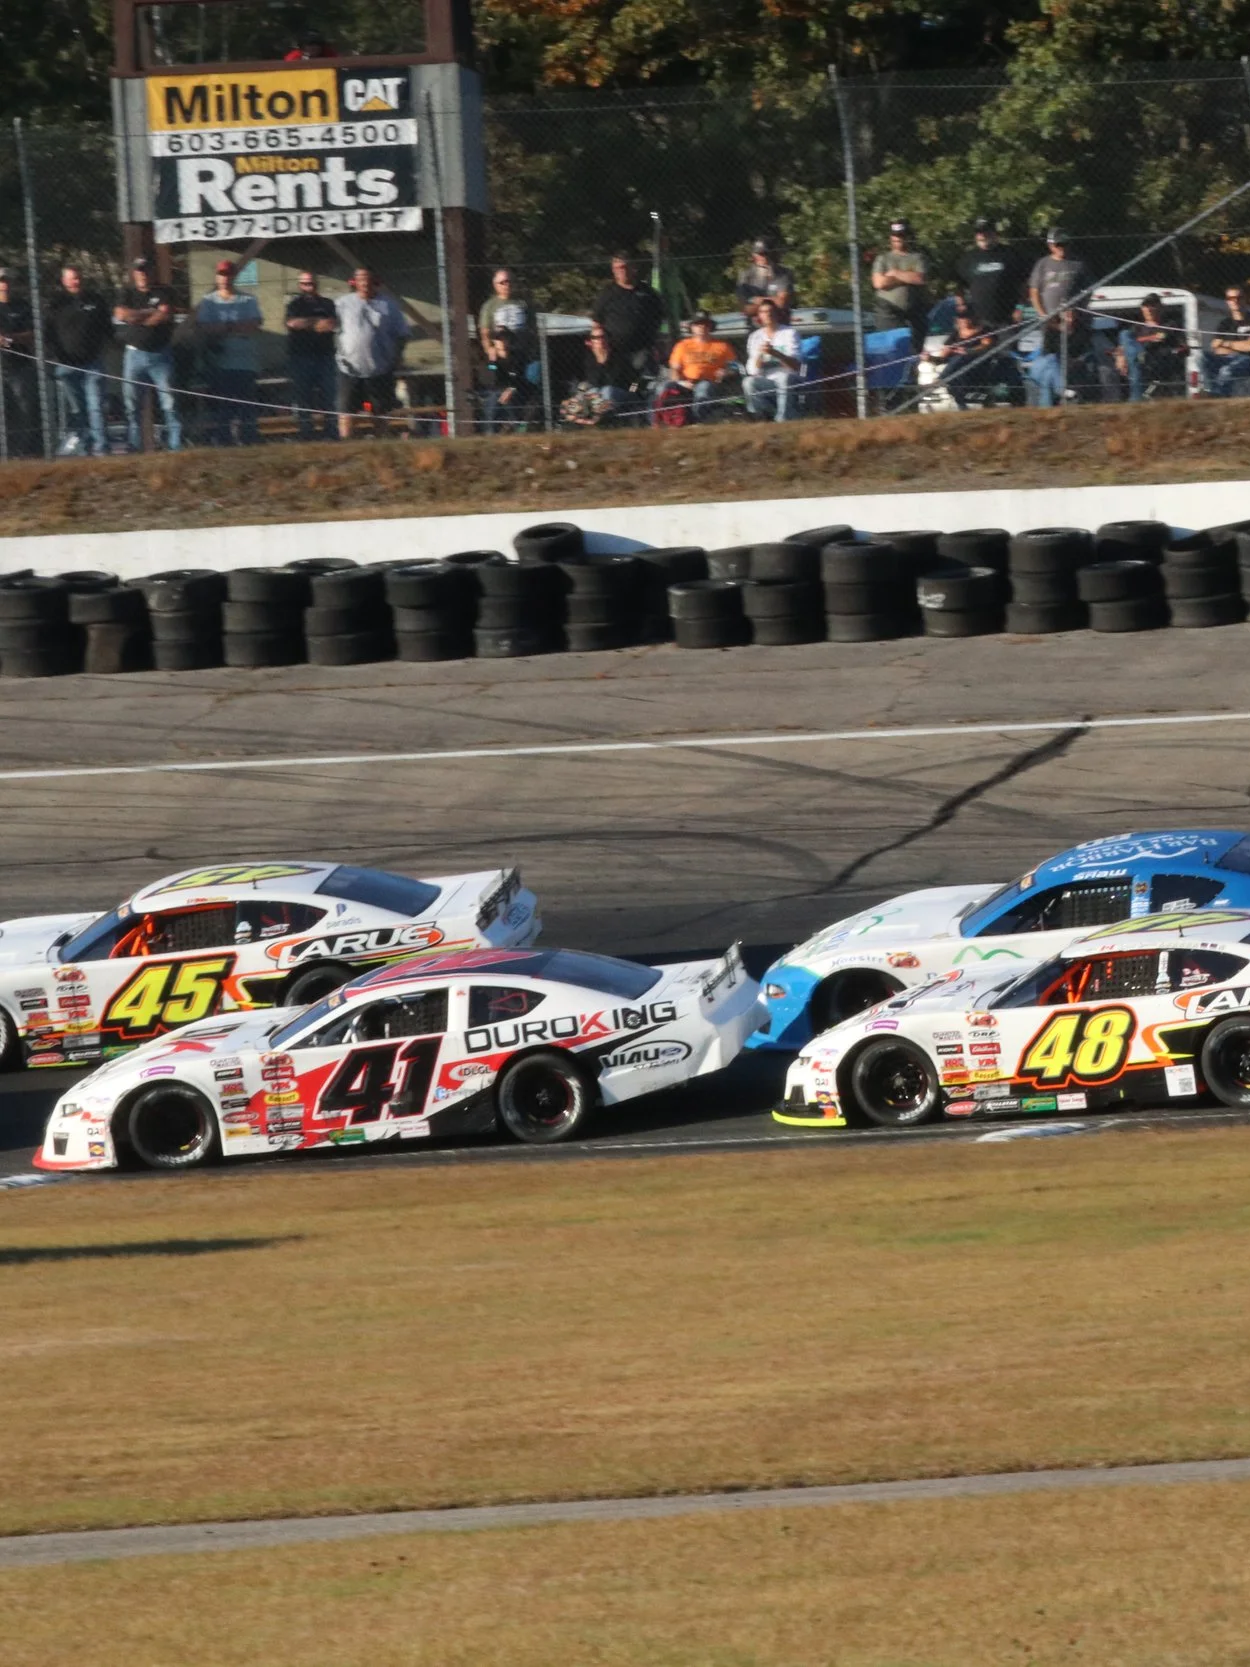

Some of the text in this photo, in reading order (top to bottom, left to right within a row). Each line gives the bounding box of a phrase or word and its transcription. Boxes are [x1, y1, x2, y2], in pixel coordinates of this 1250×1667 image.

[164, 84, 328, 124] Milton
[343, 77, 402, 112] CAT
[167, 123, 400, 152] 603-665-4500
[176, 156, 399, 214] Rents
[235, 156, 319, 173] Milton
[175, 211, 403, 239] 1-877-DIG-LIFT
[277, 922, 437, 969] LARUE
[105, 956, 229, 1029] 45
[464, 1001, 676, 1053] DUROKING
[1024, 1009, 1132, 1079] 48
[601, 1047, 660, 1068] VIAU
[319, 1035, 443, 1125] 41
